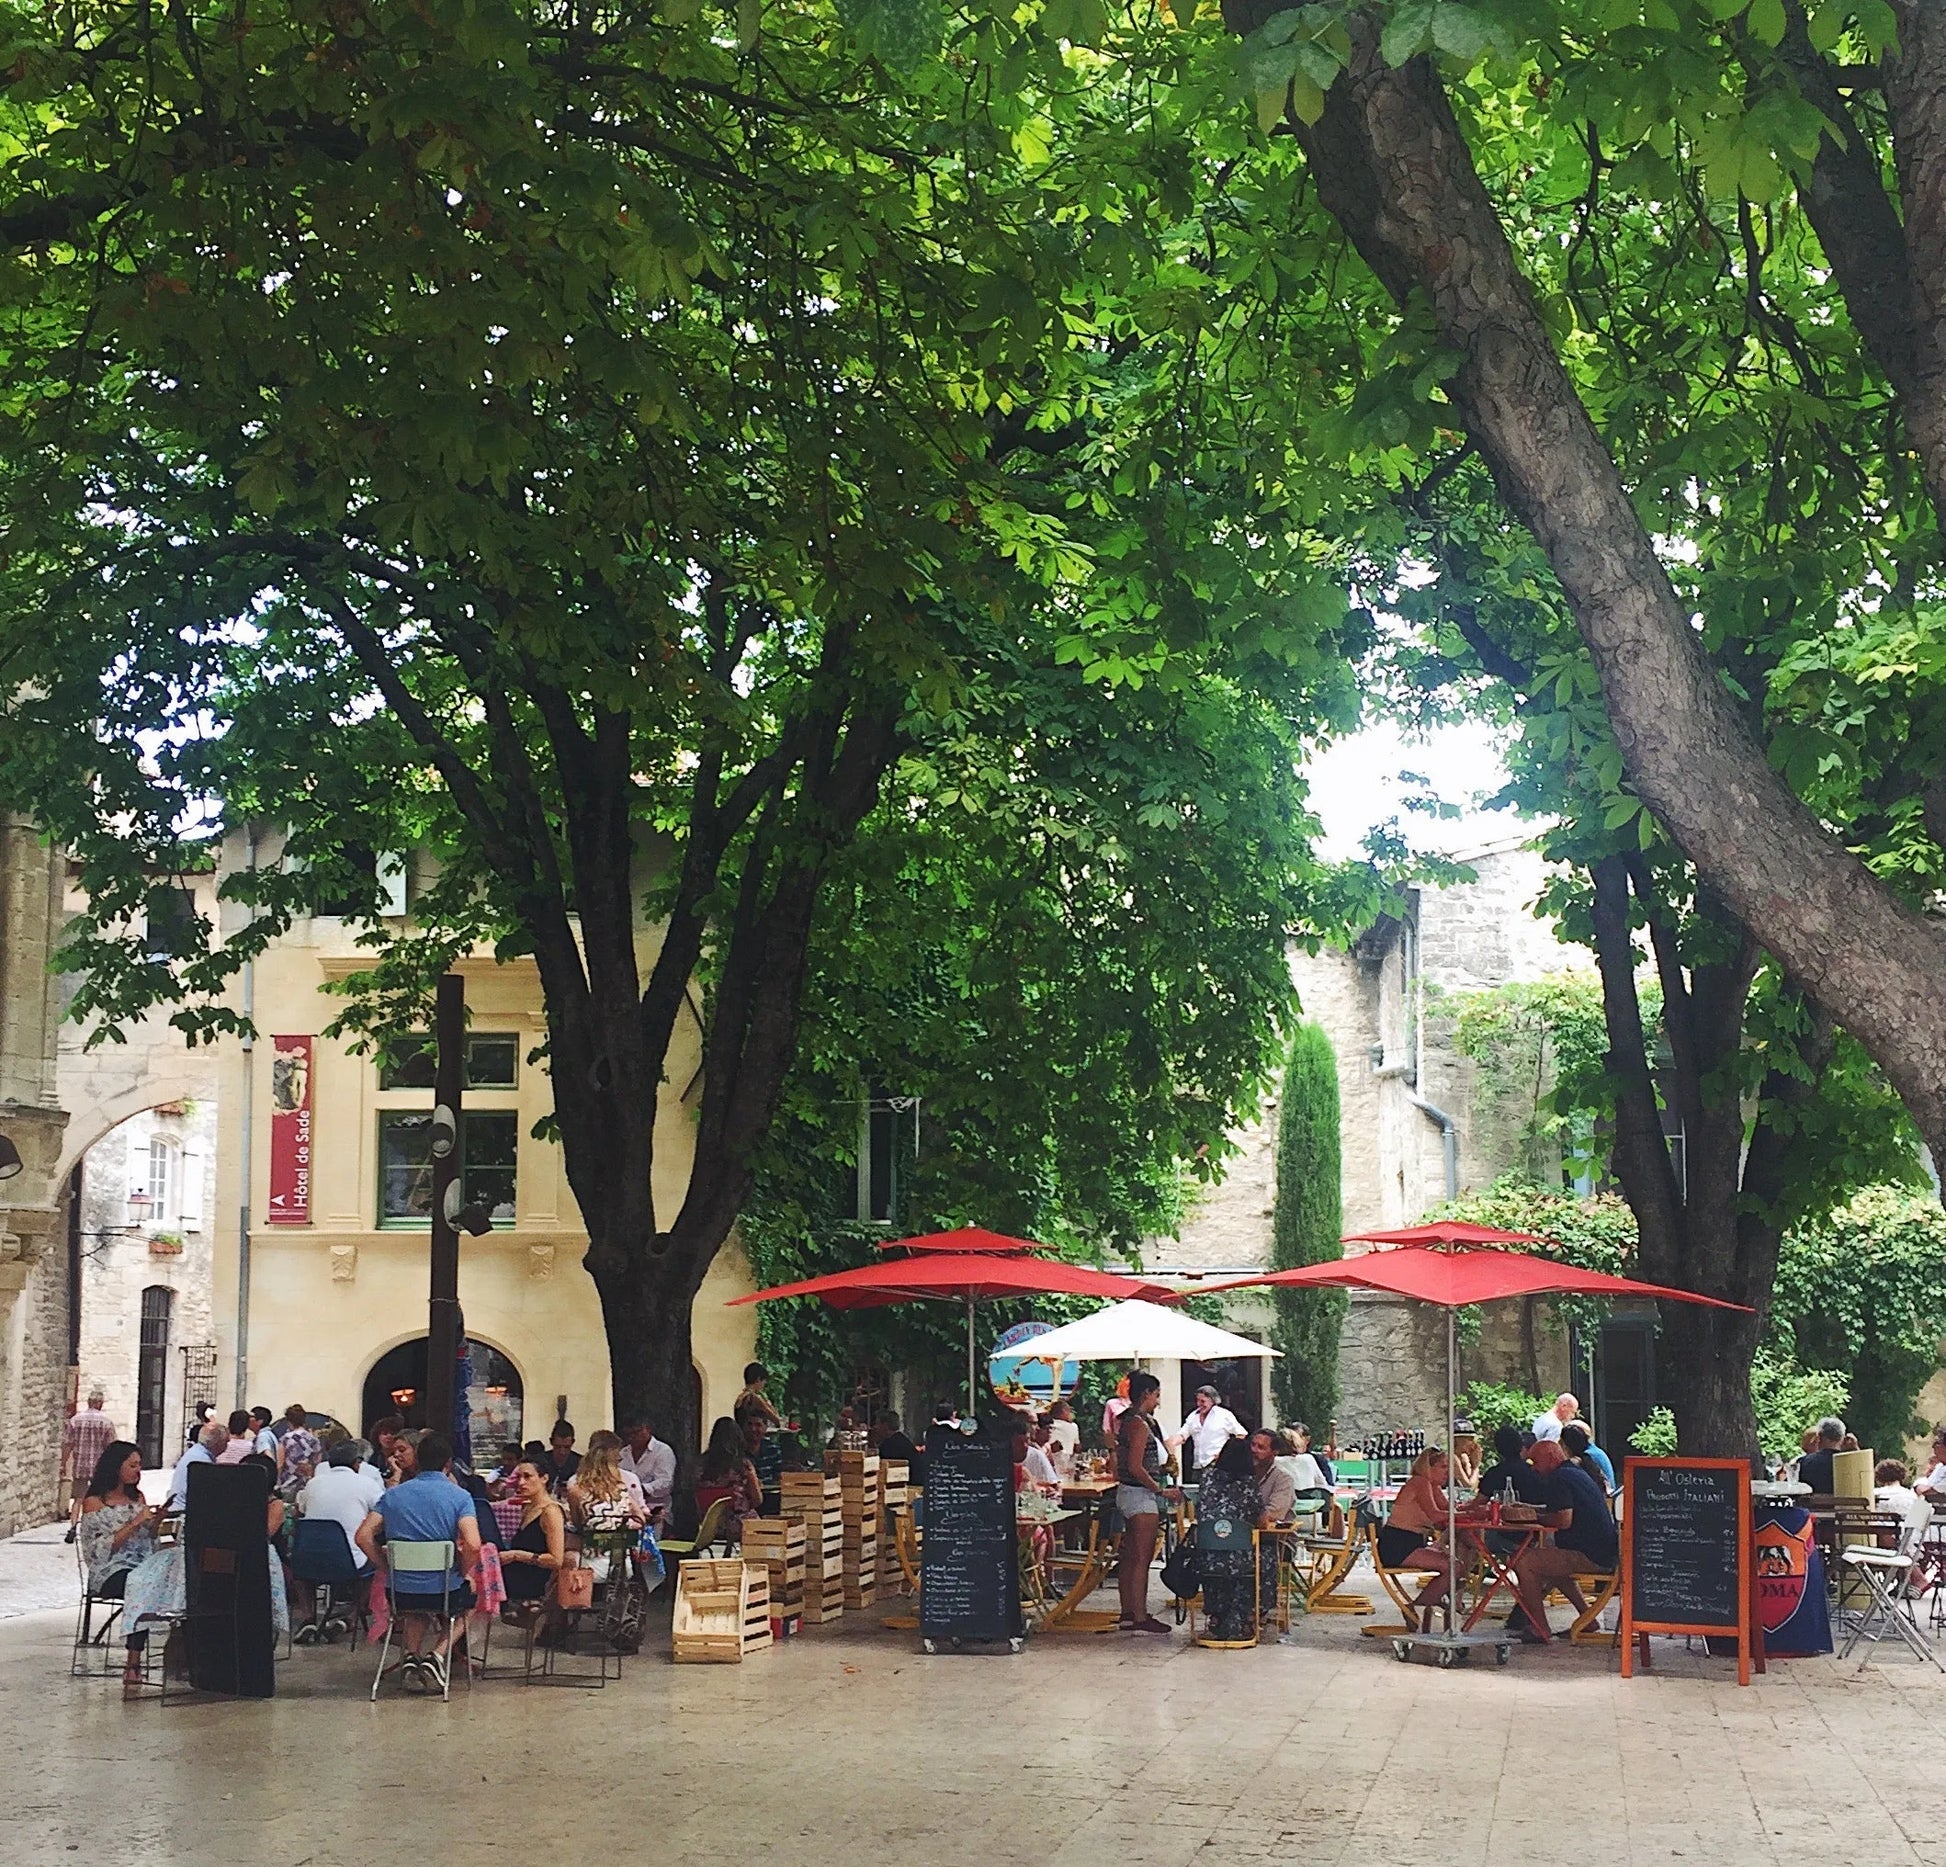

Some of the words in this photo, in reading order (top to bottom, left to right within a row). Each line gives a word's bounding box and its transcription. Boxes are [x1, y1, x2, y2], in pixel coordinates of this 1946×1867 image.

[296, 1110, 310, 1143] Sade
[295, 1148, 309, 1164] de
[293, 1169, 308, 1207] Hôtel
[1760, 1583, 1800, 1598] OMA
